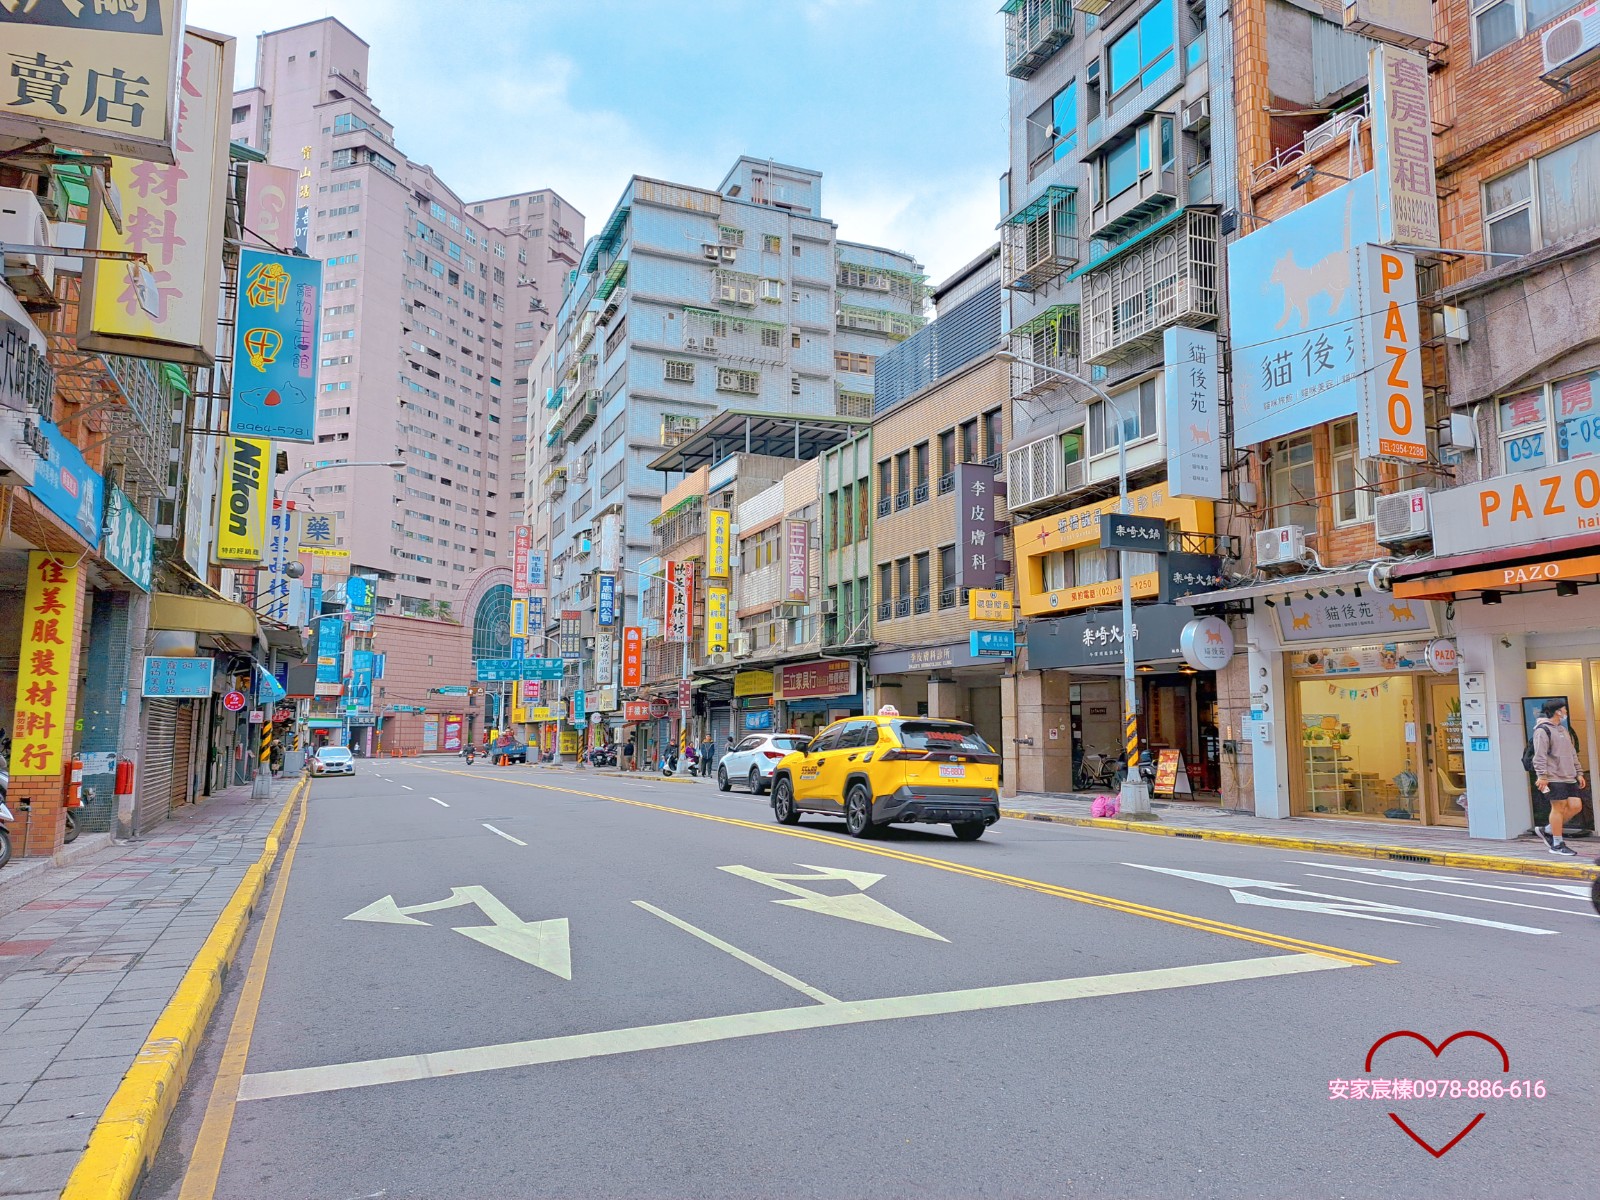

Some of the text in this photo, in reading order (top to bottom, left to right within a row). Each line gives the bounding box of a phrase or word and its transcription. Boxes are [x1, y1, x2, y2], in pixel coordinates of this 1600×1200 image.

[7, 52, 150, 127] 賣店
[1387, 56, 1434, 197] 套房自租
[1380, 253, 1413, 436] PAZO
[1188, 342, 1207, 414] 貓後苑
[1508, 378, 1593, 427] 套房
[236, 422, 310, 437] 8964-5781
[1380, 441, 1424, 457] TEL:2954-2288
[229, 438, 262, 537] Nikon
[1480, 469, 1600, 527] PAZO
[306, 516, 331, 541] 藥
[971, 481, 987, 570] 李皮膚科
[221, 546, 259, 557] 特約經銷商
[790, 523, 805, 592] 三立家具
[1504, 564, 1559, 584] PAZO
[600, 578, 613, 623] 千恩眼鏡公司
[1324, 602, 1373, 622] 貓後苑
[19, 557, 69, 771] 佳美服裝材料行
[628, 643, 637, 677] 手機家
[1435, 649, 1456, 660] PAZO
[783, 670, 817, 691] 三立家具行
